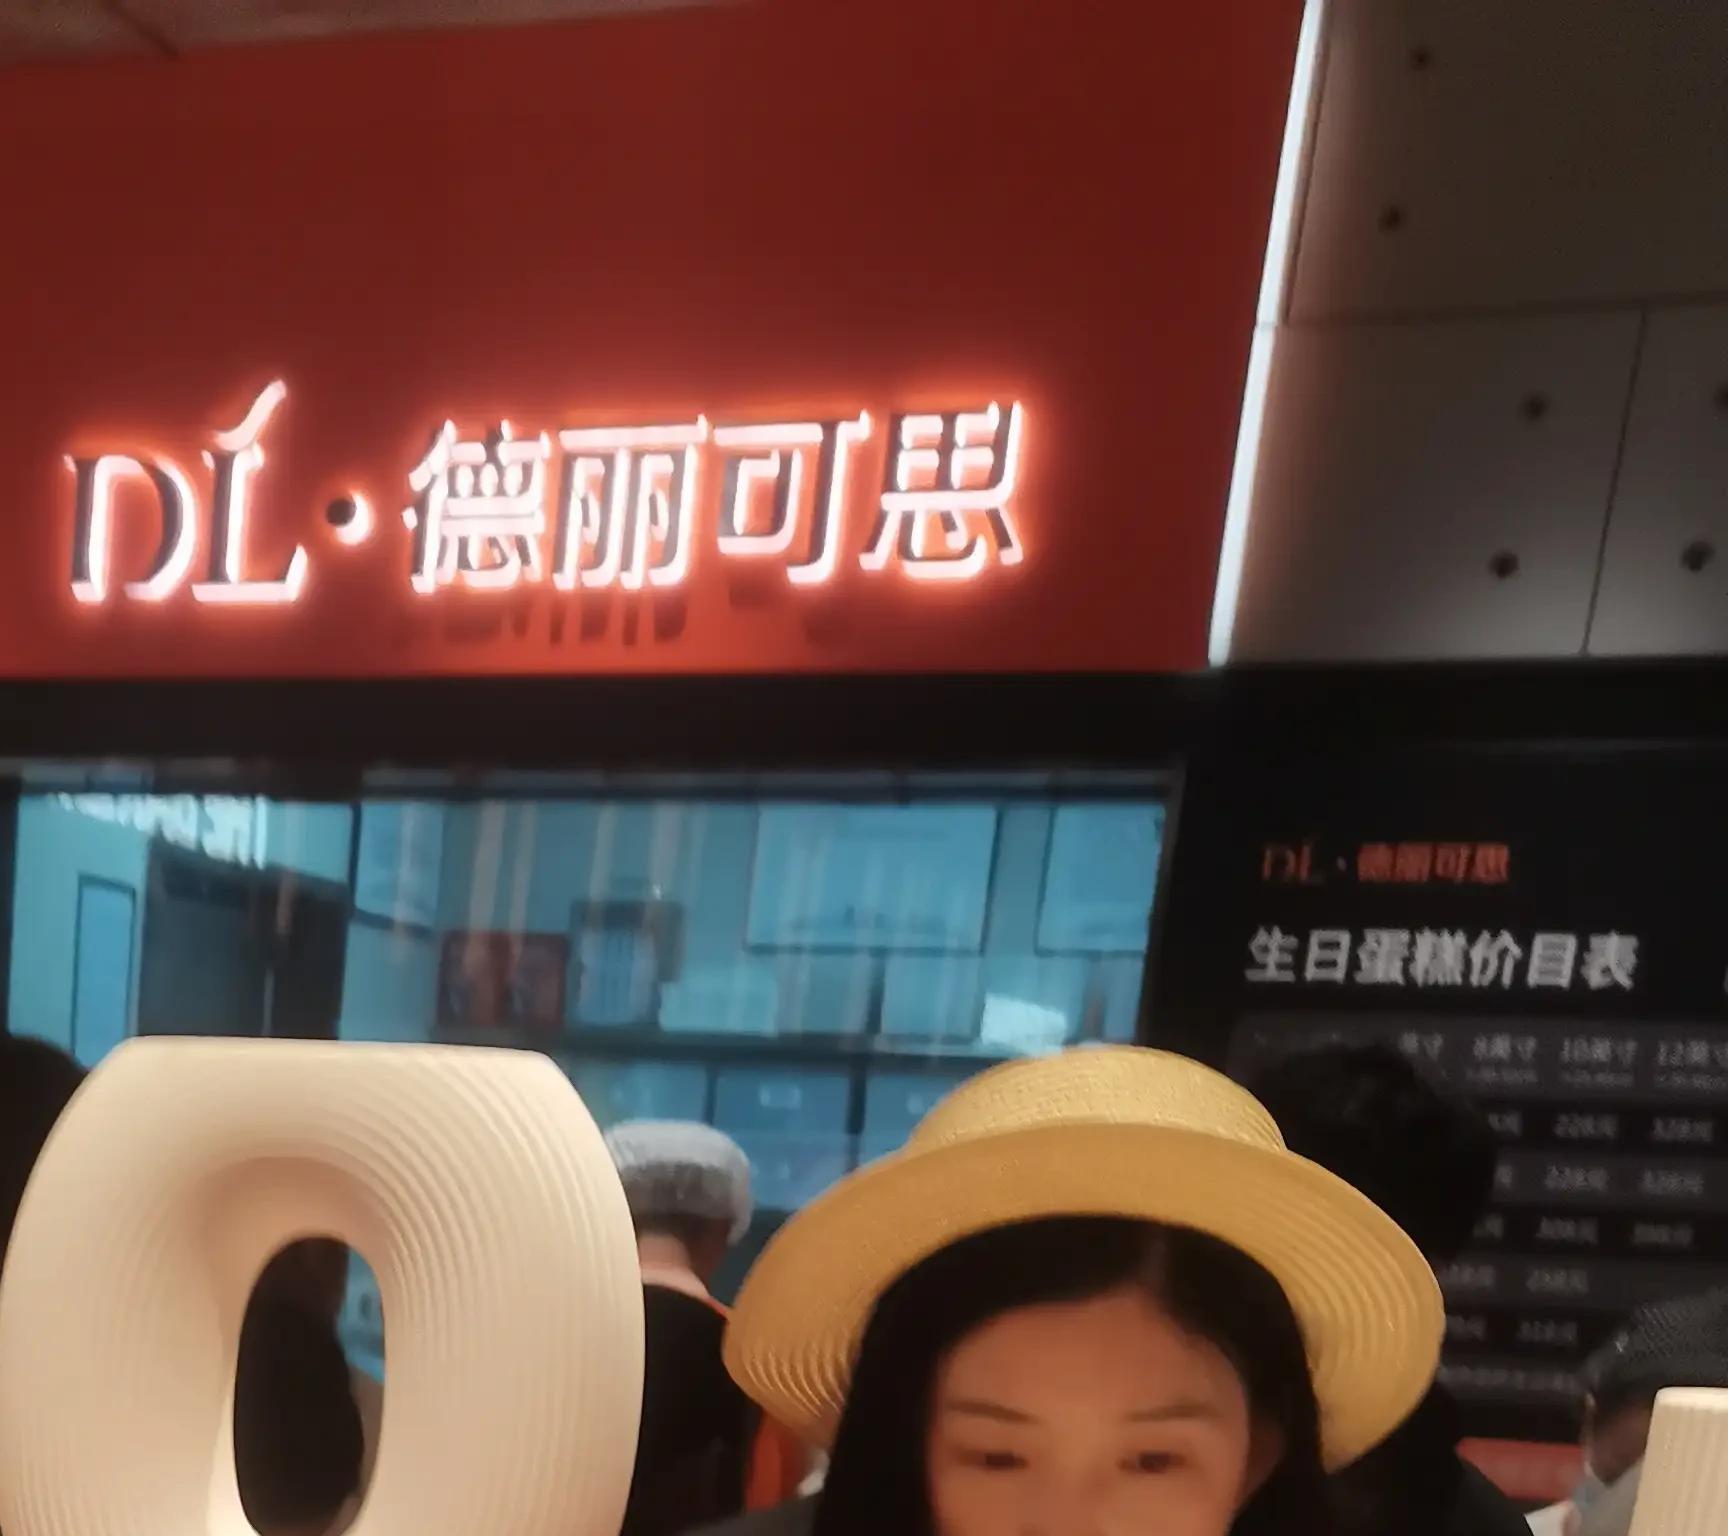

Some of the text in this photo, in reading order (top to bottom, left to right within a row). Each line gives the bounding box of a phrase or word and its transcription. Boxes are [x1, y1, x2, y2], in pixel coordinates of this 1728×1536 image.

[1245, 926, 1638, 990] 生日蛋糕价目表
